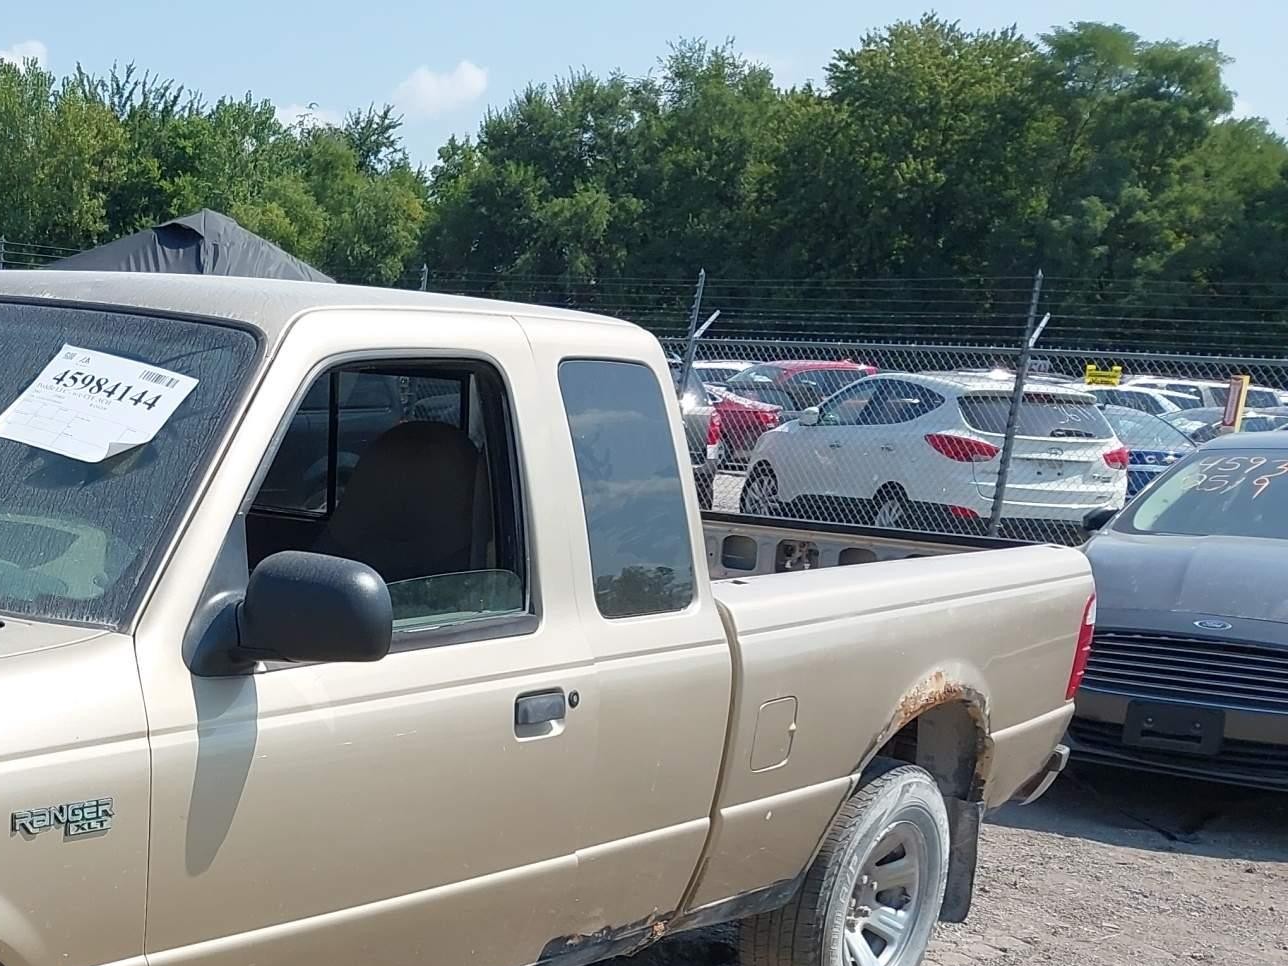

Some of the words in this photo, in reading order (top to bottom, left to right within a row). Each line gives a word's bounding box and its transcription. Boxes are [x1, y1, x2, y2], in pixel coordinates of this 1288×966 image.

[52, 369, 163, 411] 45984144
[11, 797, 115, 834] RANGER
[74, 819, 109, 833] XLT
